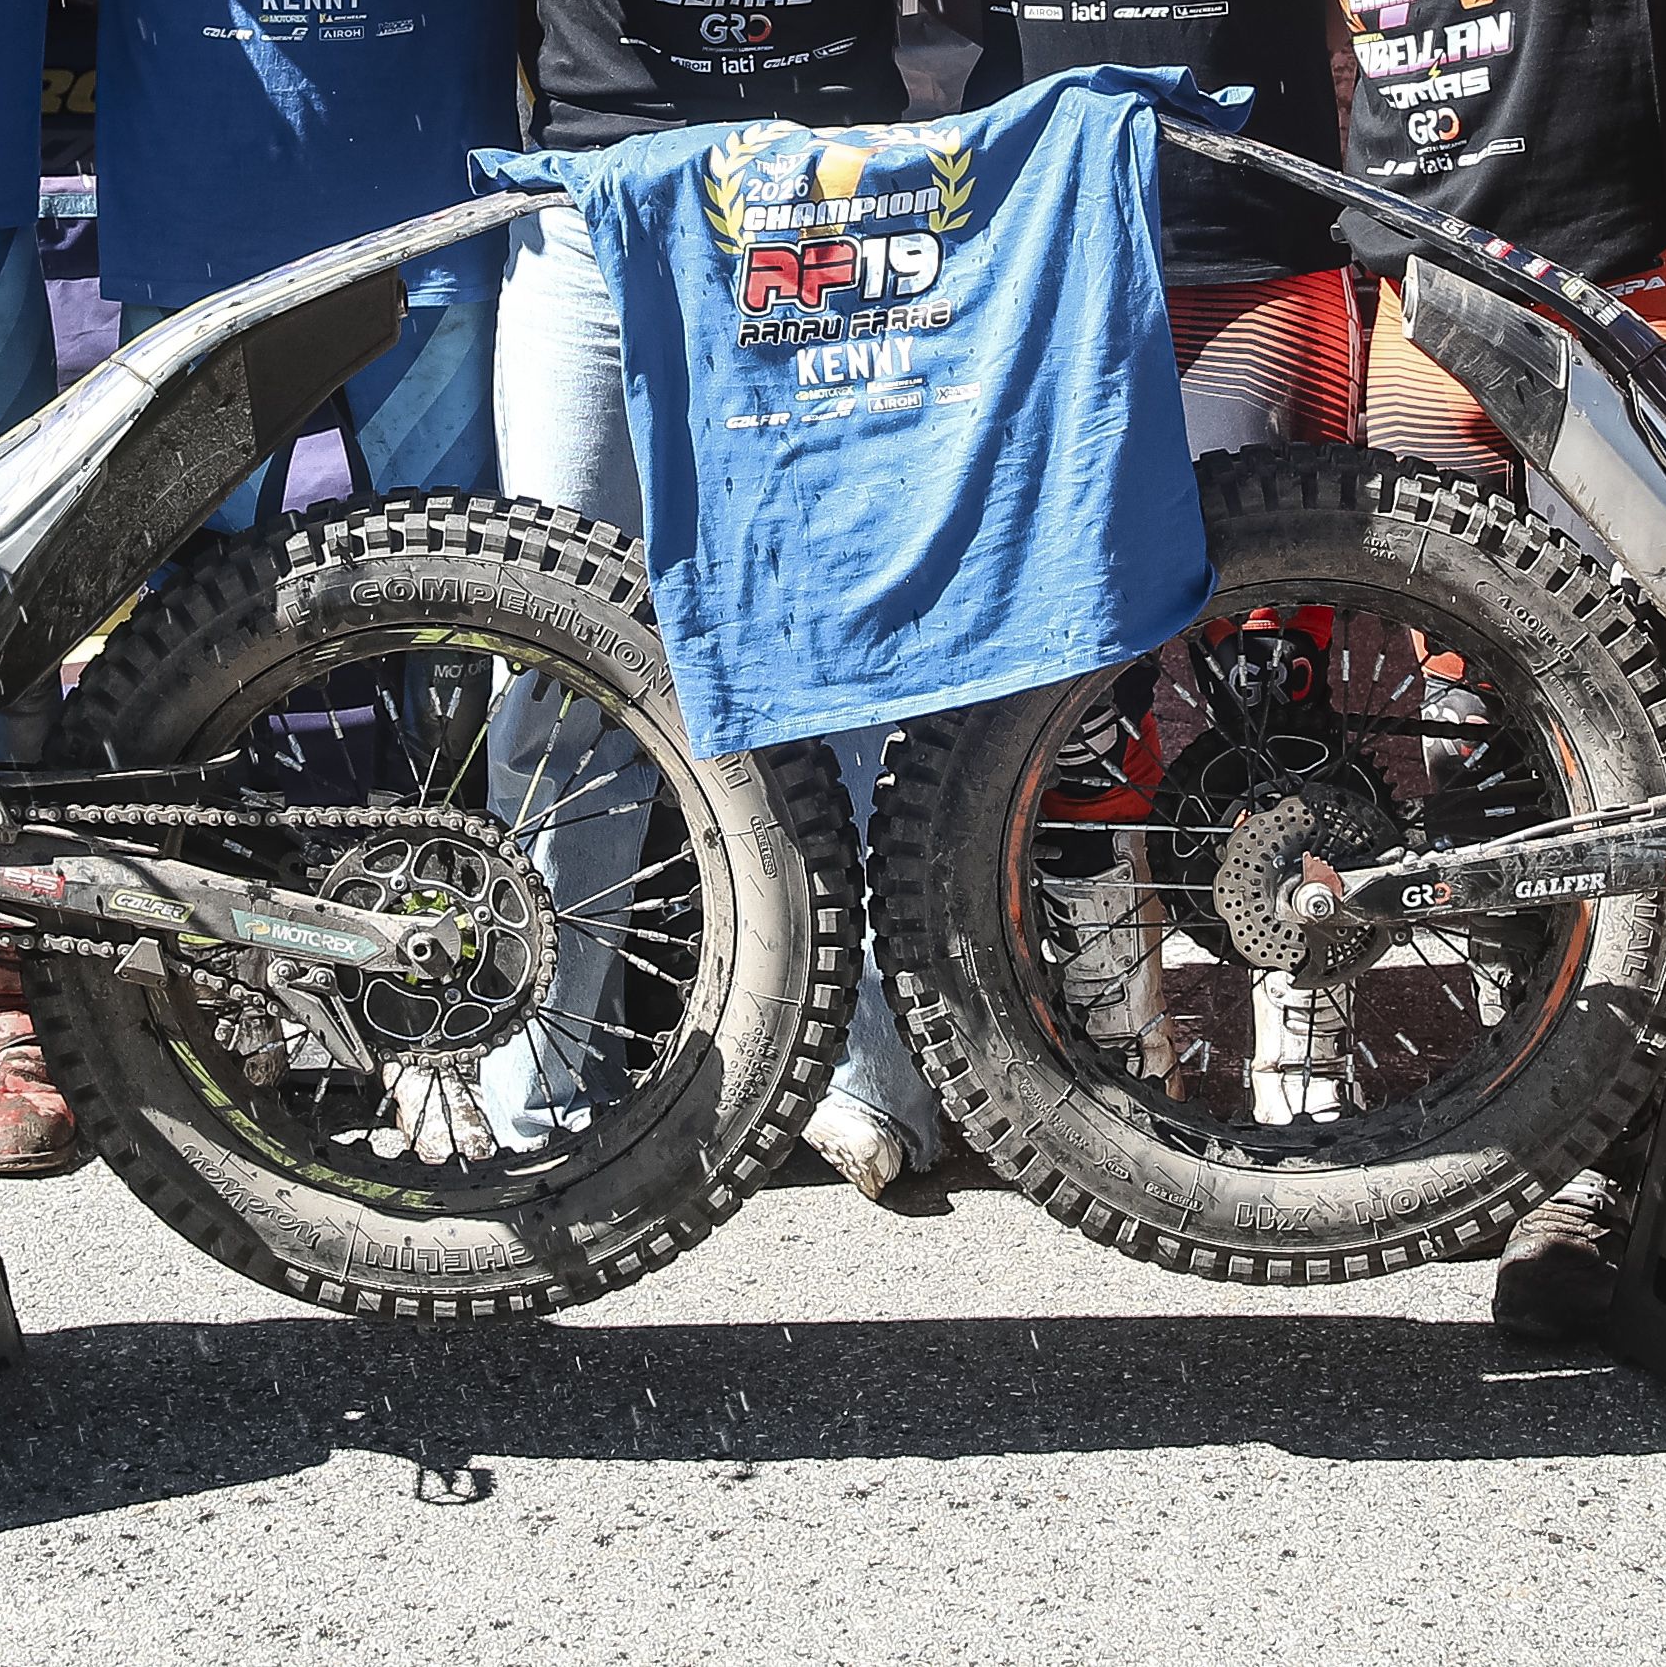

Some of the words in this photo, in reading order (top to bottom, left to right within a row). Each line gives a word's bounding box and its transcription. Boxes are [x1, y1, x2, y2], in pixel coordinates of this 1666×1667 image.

[1071, 1, 1106, 22] iati
[323, 28, 363, 40] AIROH
[721, 54, 756, 75] iati
[763, 53, 810, 70] GALFER
[745, 175, 809, 203] 2026
[742, 186, 941, 233] CHAMPION
[795, 335, 915, 387] KENNY
[350, 574, 675, 701] COMPETITION
[1515, 872, 1607, 900] GALFER
[115, 893, 186, 920] GALFER
[271, 922, 359, 956] MOTOREX
